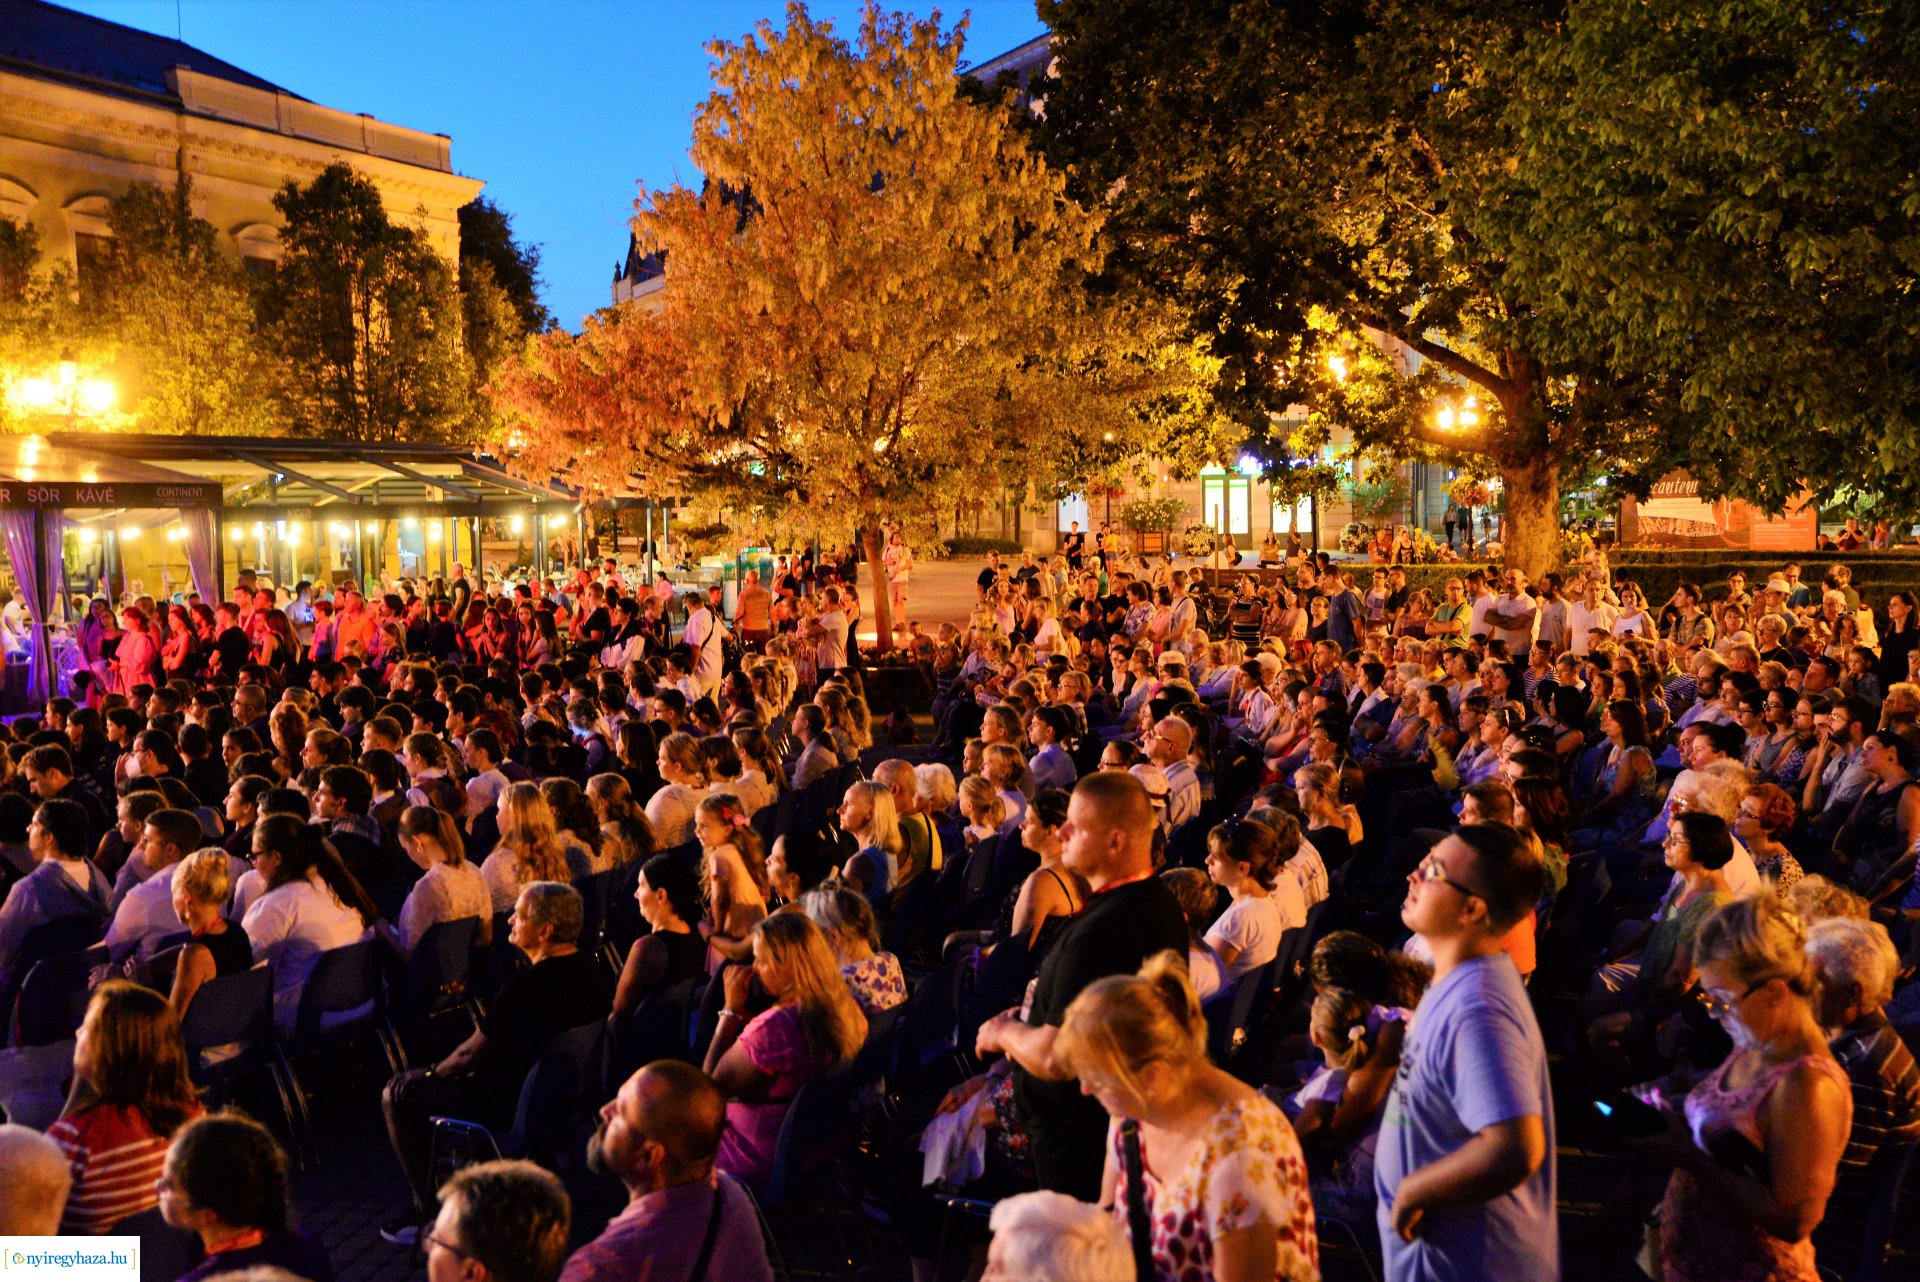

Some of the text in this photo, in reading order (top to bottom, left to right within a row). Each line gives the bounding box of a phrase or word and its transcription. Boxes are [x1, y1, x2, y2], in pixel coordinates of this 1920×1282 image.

[27, 487, 61, 502] SÖR
[76, 486, 114, 502] KÁVÉ
[156, 487, 203, 497] CONTINENT
